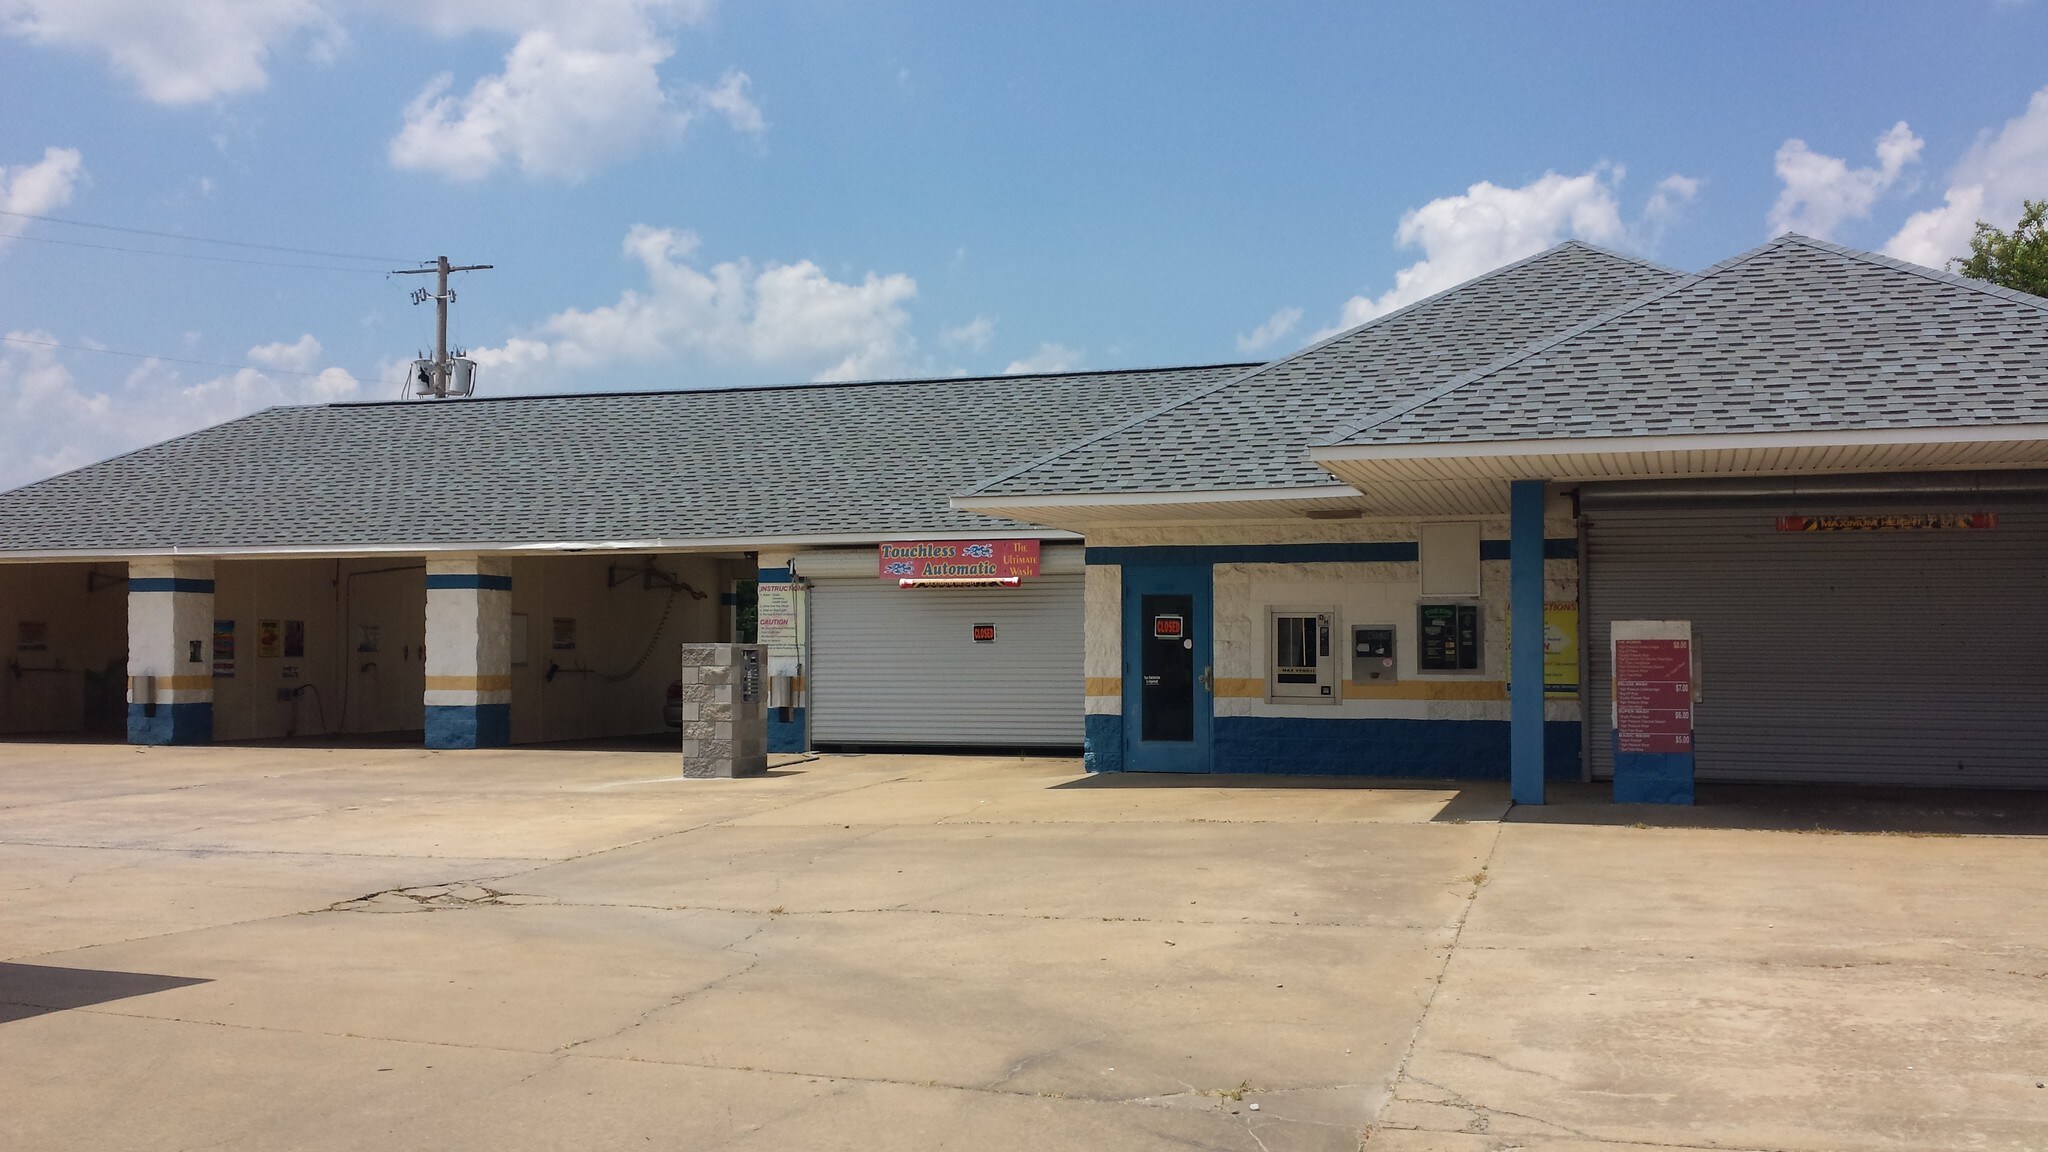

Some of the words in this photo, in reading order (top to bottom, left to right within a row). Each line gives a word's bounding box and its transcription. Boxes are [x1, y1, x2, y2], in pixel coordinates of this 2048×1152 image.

[882, 544, 956, 559] Touchless
[1013, 542, 1028, 552] The
[922, 561, 997, 576] Automatic
[1009, 566, 1033, 576] Wash
[1157, 620, 1180, 632] CLOSED
[974, 628, 994, 639] CLOSED
[1675, 684, 1689, 692] $7.00
[1675, 736, 1690, 744] $5.00
